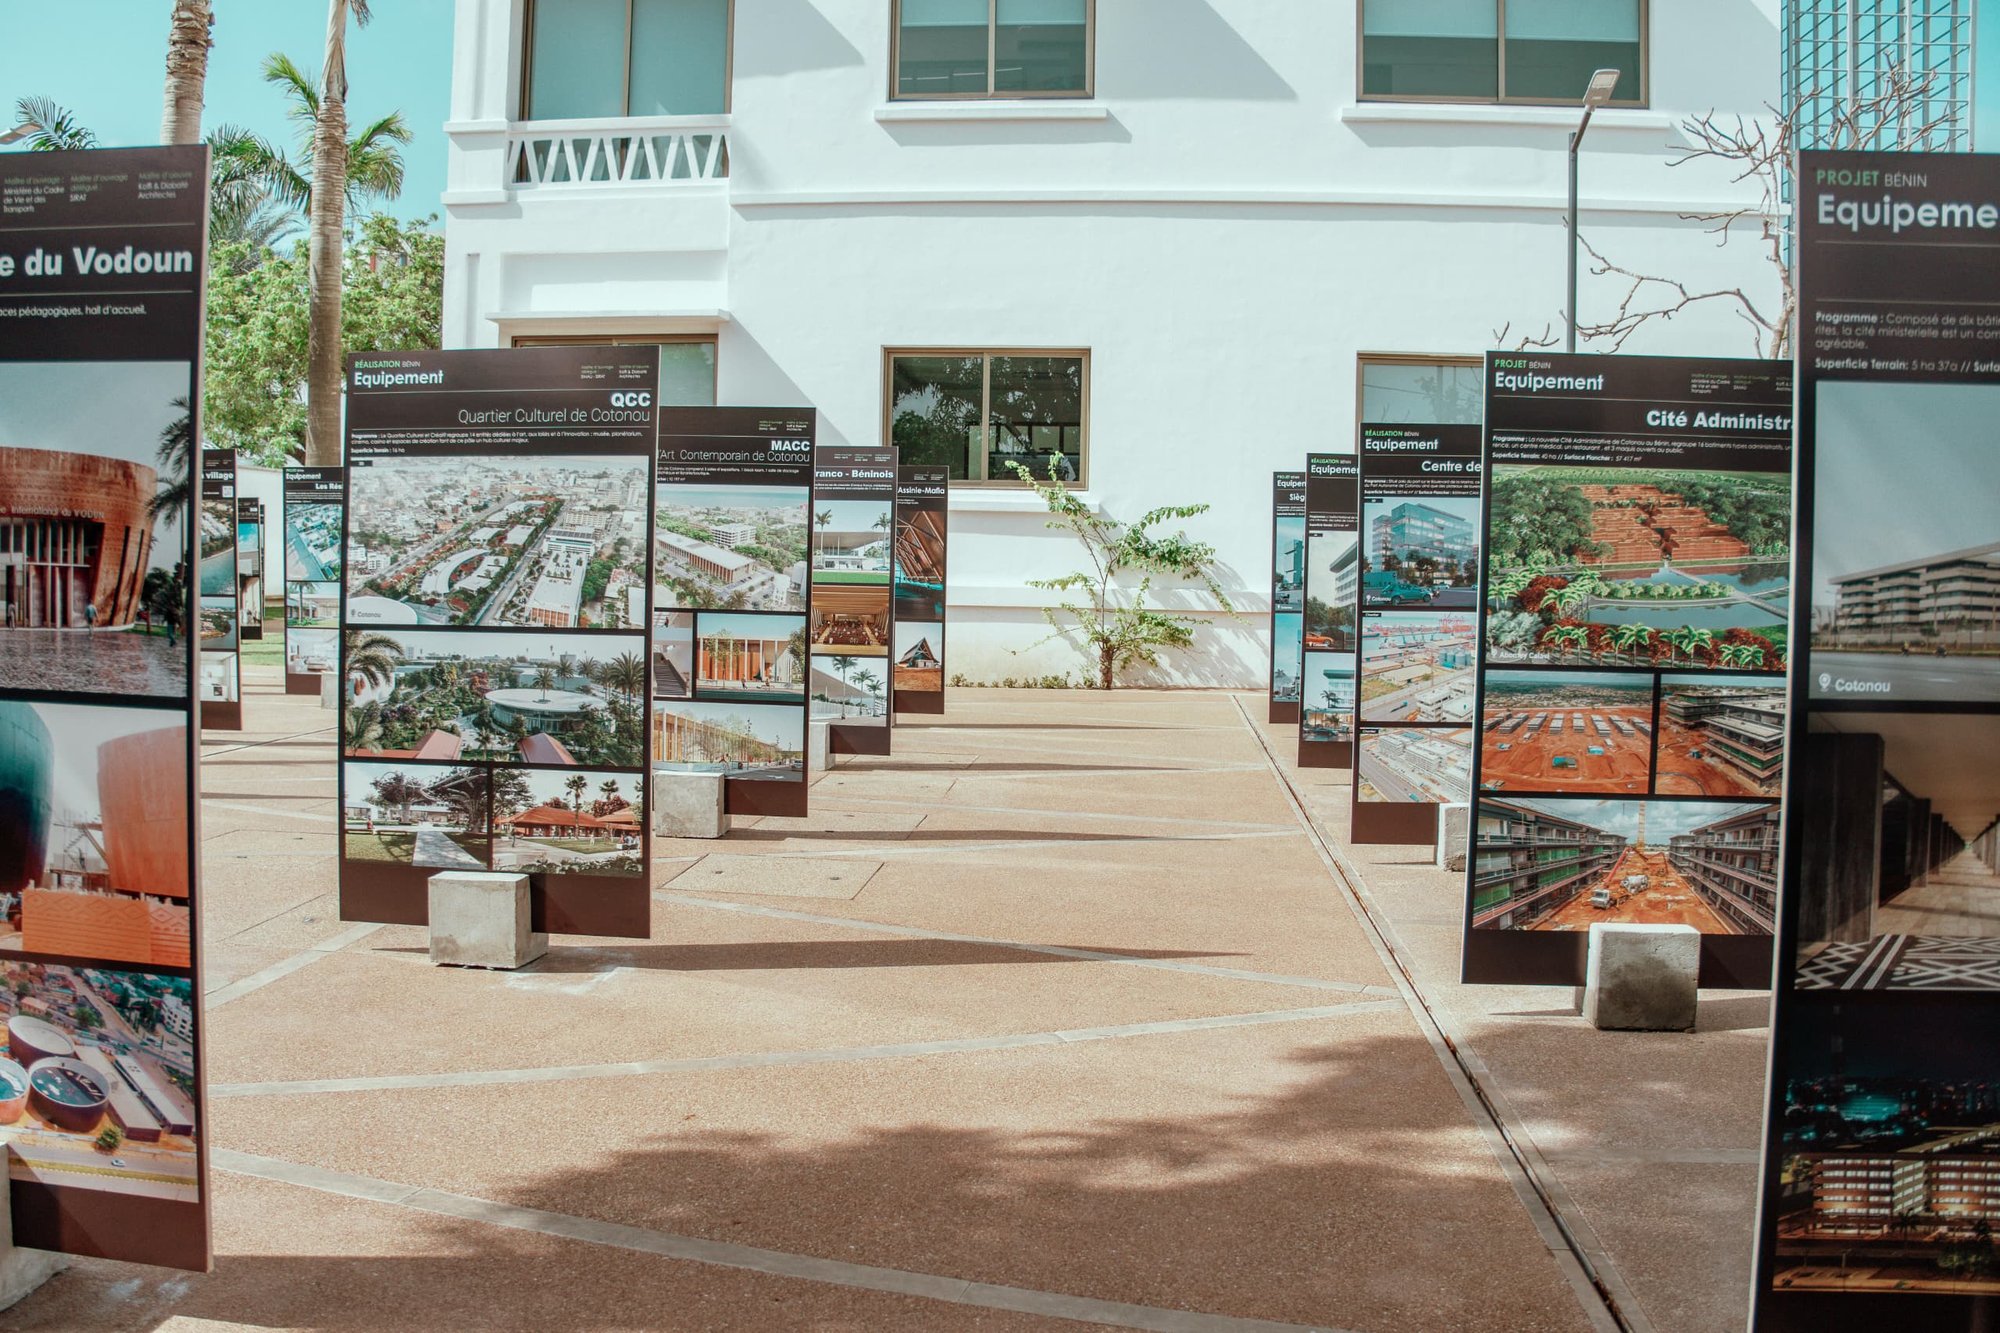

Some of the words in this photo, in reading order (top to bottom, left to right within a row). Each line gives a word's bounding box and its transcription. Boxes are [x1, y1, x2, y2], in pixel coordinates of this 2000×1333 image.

[1816, 169, 1879, 187] PROJET
[1884, 172, 1927, 188] BÉNIN
[24, 248, 62, 276] du
[73, 246, 193, 275] Vodoun
[85, 305, 101, 315] hall
[103, 303, 147, 315] d'accueil.
[1816, 311, 1878, 324] Programme
[1886, 313, 1939, 325] Composé
[1941, 315, 1956, 325] de
[1959, 315, 1974, 325] dix
[1842, 325, 1852, 335] la
[1854, 325, 1875, 336] cité
[1942, 328, 1957, 338] est
[1960, 330, 1974, 338] un
[1815, 339, 1868, 351] agréable.
[354, 360, 400, 369] RÉALISATION
[1494, 358, 1527, 369] PROJET
[1528, 360, 1551, 369] BÉNIN
[1815, 357, 1868, 370] Superficie
[1920, 360, 1935, 371] ha
[354, 369, 444, 388] Equipement
[1495, 371, 1604, 392] Equipement
[610, 392, 650, 408] QCC
[458, 408, 512, 424] Quartier
[515, 408, 567, 423] Culturel
[570, 408, 587, 422] de
[591, 407, 650, 422] Cotonou
[1646, 410, 1688, 427] Cité
[1693, 411, 1793, 431] Administr
[1364, 429, 1402, 437] RÉALISATION
[771, 440, 810, 451] MACC
[1365, 438, 1438, 451] Equipement
[680, 449, 750, 462] Contemporain
[752, 451, 765, 461] de
[767, 451, 810, 463] Cotonou
[1421, 460, 1462, 472] Centre
[1466, 461, 1481, 472] de
[206, 472, 234, 481] village
[851, 469, 894, 478] Béninois
[898, 487, 945, 495] Assinie-Mafia
[1834, 678, 1891, 692] Cotonou
